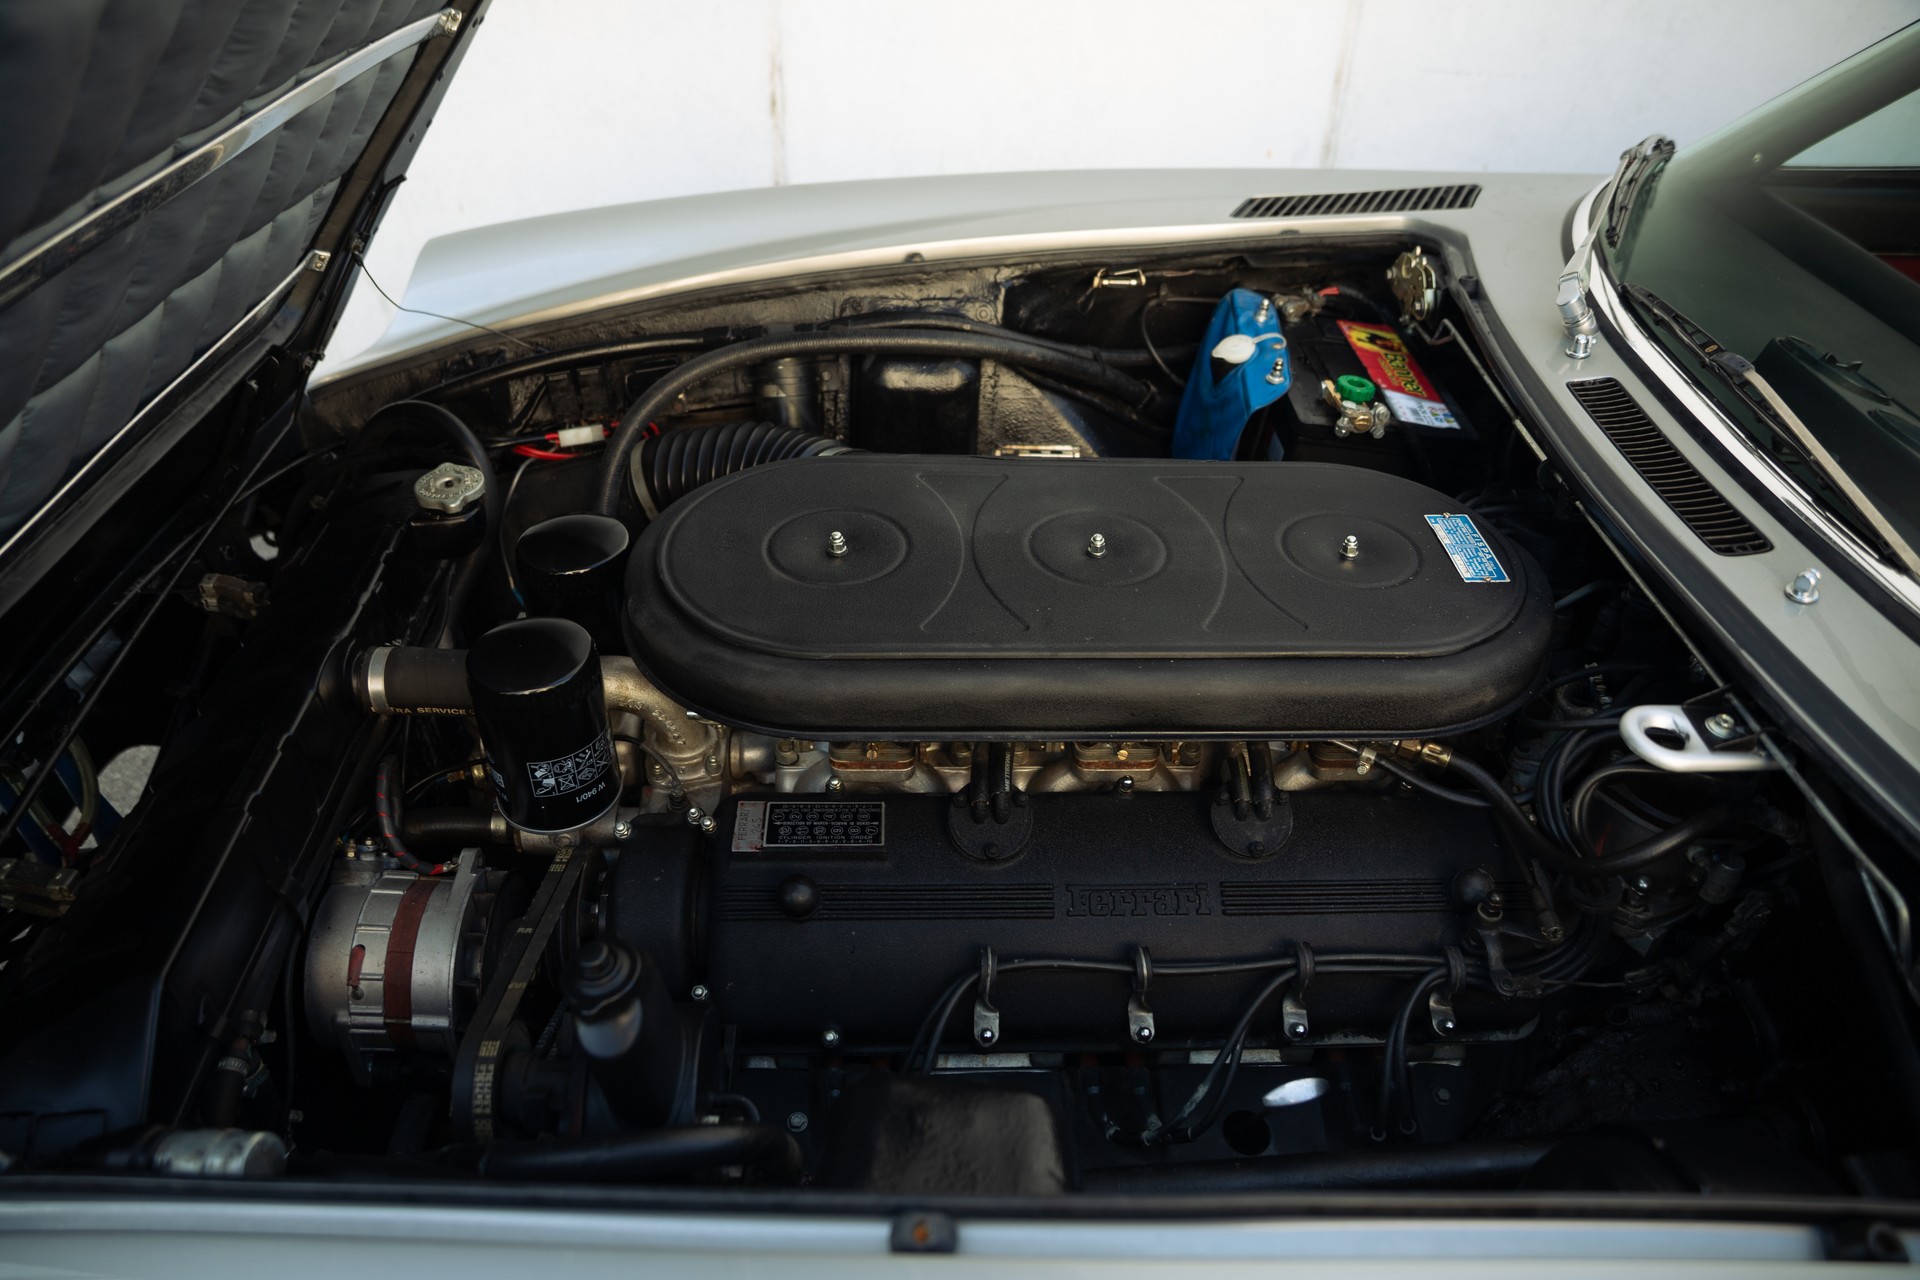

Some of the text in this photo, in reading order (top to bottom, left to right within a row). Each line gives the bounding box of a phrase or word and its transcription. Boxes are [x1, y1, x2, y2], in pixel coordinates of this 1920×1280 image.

[1383, 352, 1428, 398] Banner
[1471, 533, 1492, 559] FISPA
[416, 706, 466, 715] SERVICE
[575, 781, 606, 804] W 940/1
[737, 809, 750, 841] FERRARI
[1065, 882, 1211, 917] Ferrari
